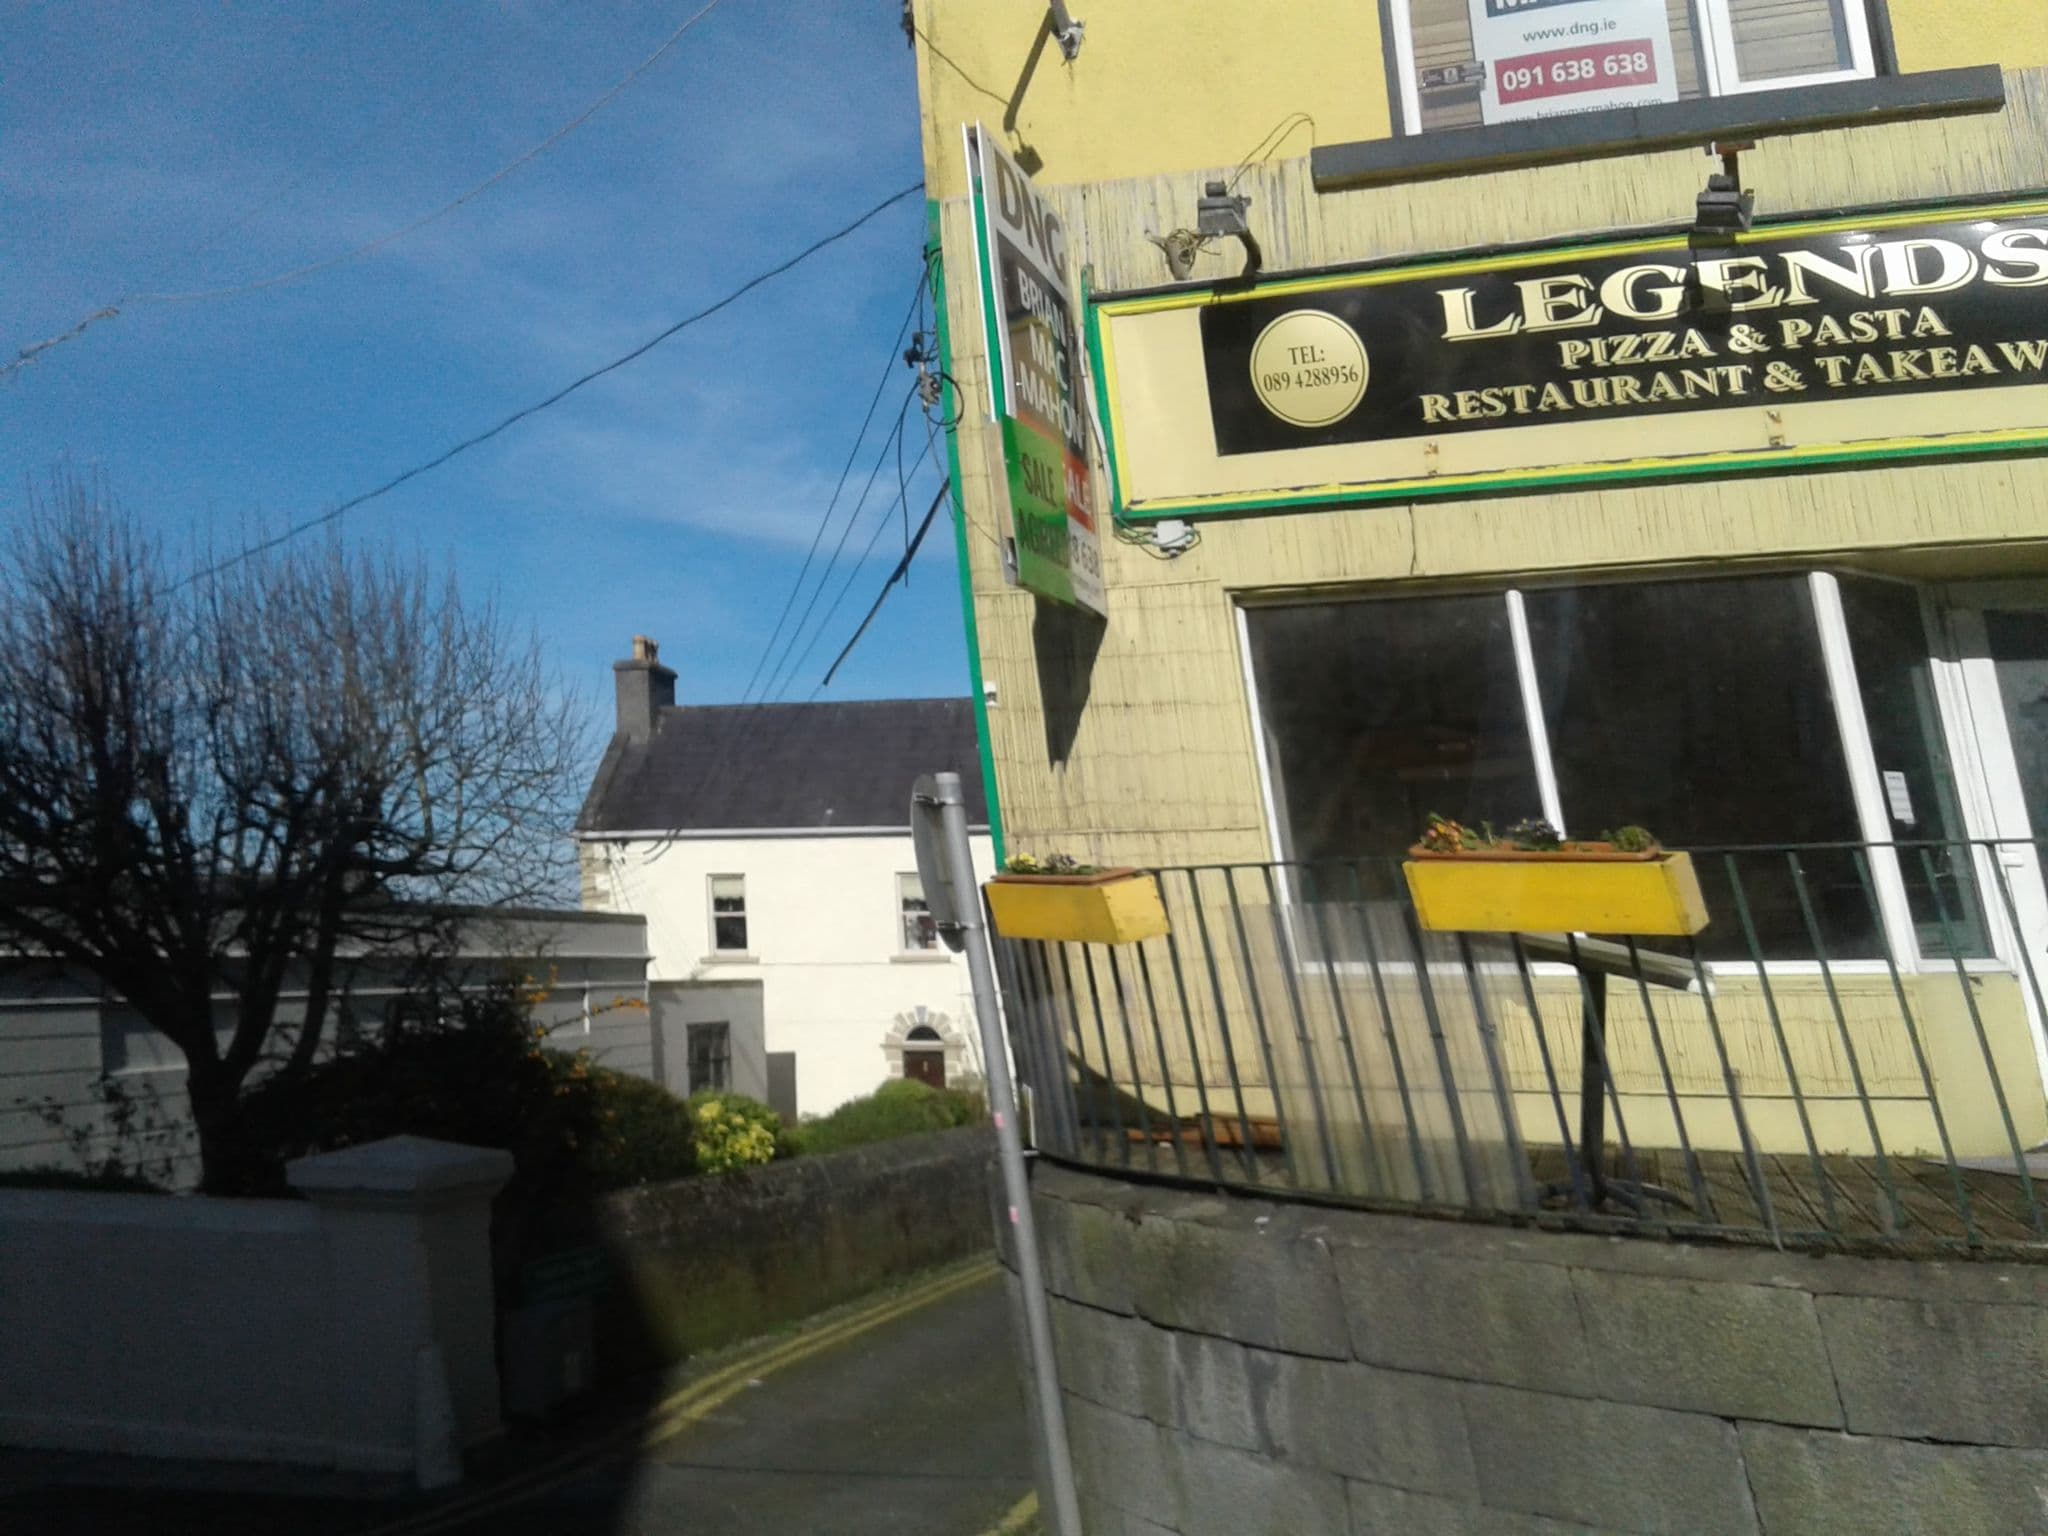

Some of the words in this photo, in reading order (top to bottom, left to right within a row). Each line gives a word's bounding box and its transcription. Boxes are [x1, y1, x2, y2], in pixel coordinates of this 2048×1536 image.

[1523, 18, 1617, 42] www.dng.ie
[1502, 65, 1544, 91] 091
[1551, 58, 1595, 81] 638
[1603, 52, 1649, 76] 638
[1017, 266, 1067, 347] BRIAN
[1435, 228, 2048, 342] LEGENDS
[1029, 322, 1068, 391] MAC
[1288, 346, 1325, 366] TEL:
[1559, 328, 1718, 370] PIZZA
[1728, 323, 1770, 355] &
[1778, 306, 1953, 349] PASTA
[1020, 360, 1084, 449] MAHON
[1263, 371, 1291, 393] 089
[1294, 364, 1359, 389] 4288956
[1419, 363, 1752, 424] RESTAURANT
[1763, 361, 1807, 392] &
[1021, 452, 1057, 508] SALE
